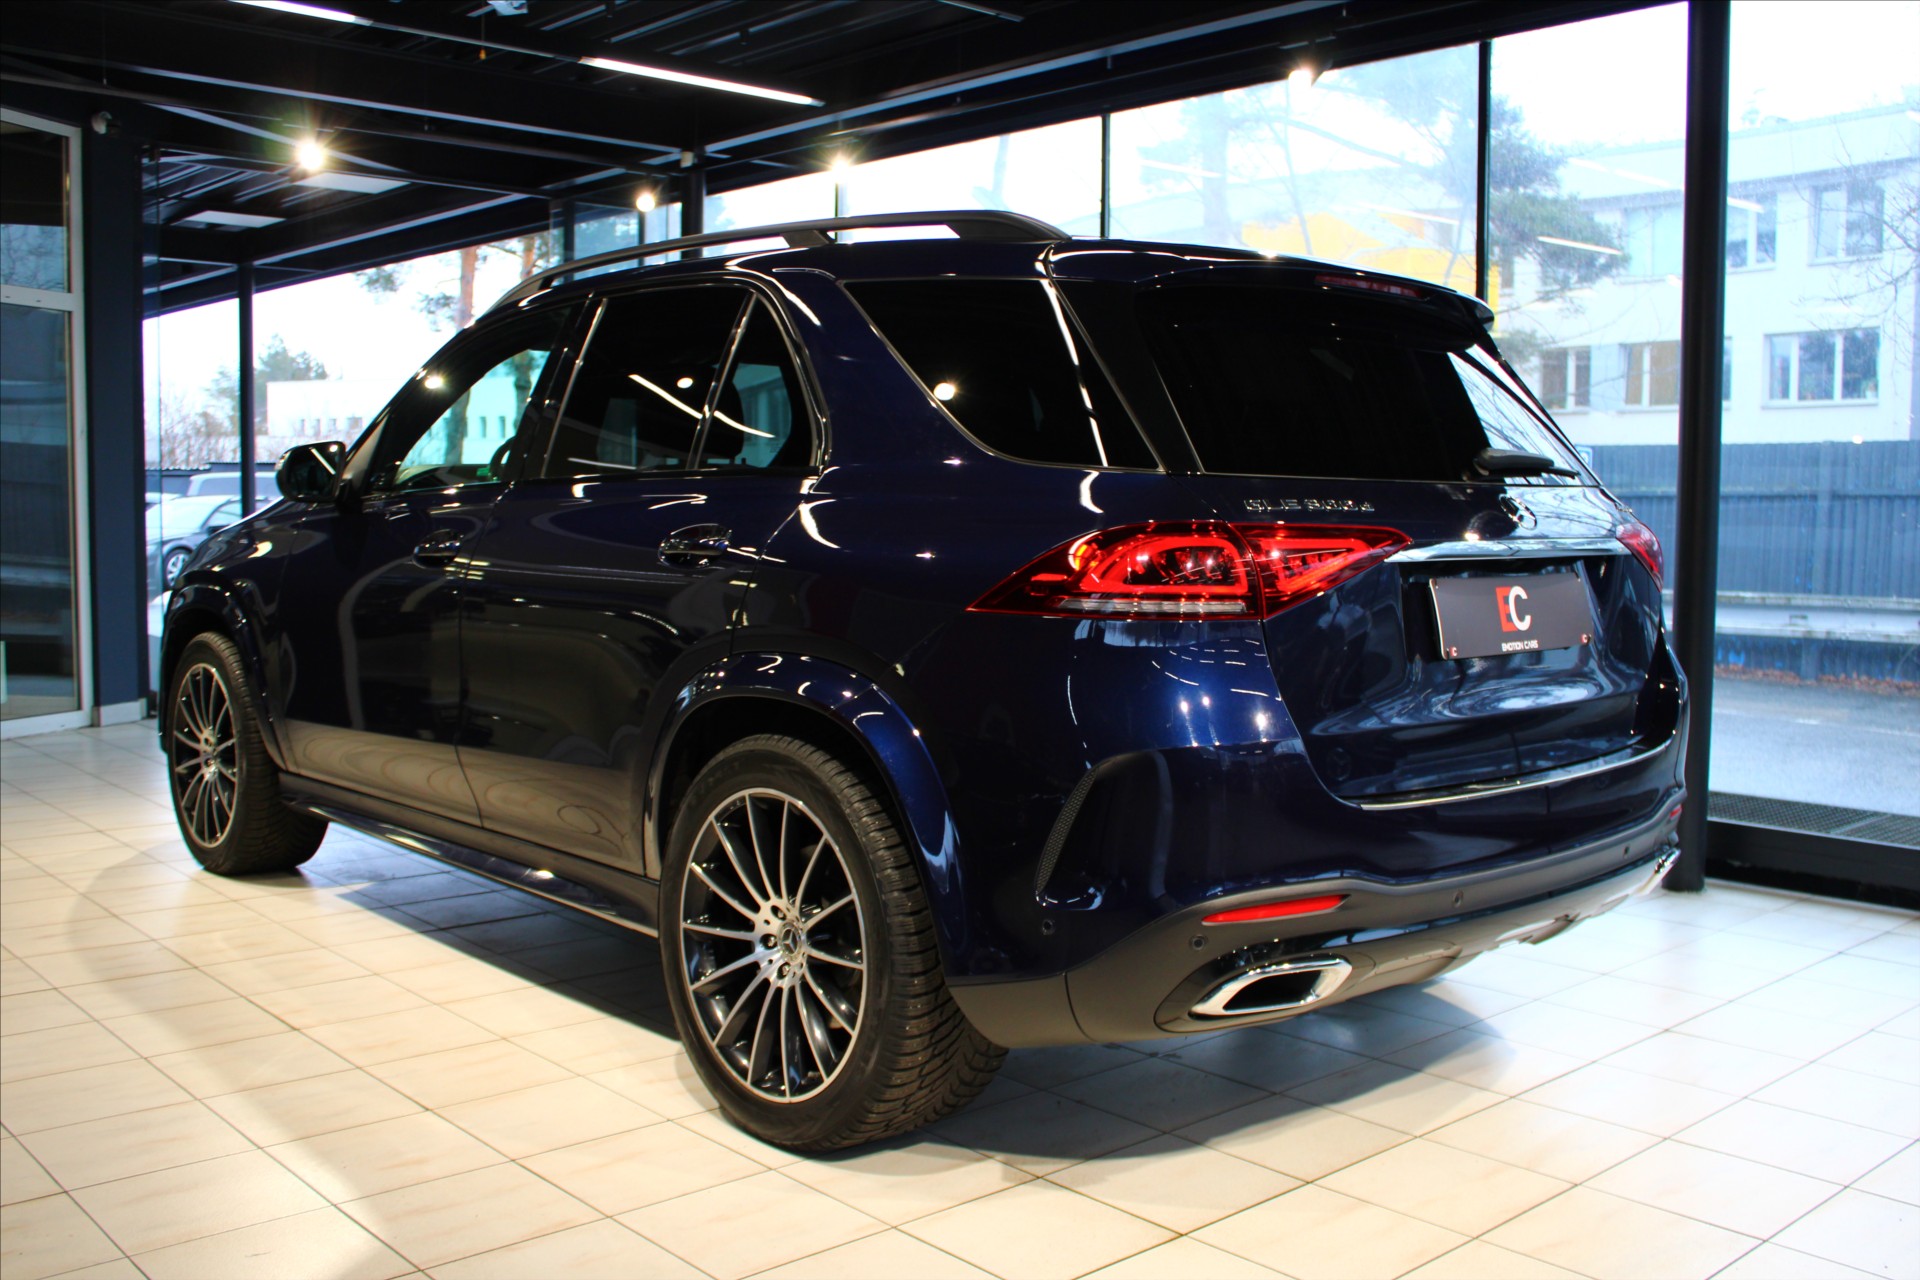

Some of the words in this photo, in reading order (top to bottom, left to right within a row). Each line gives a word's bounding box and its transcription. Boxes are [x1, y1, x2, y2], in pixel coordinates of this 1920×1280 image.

[1243, 499, 1302, 513] GLE
[1495, 585, 1532, 632] EC
[1524, 639, 1539, 650] CARS
